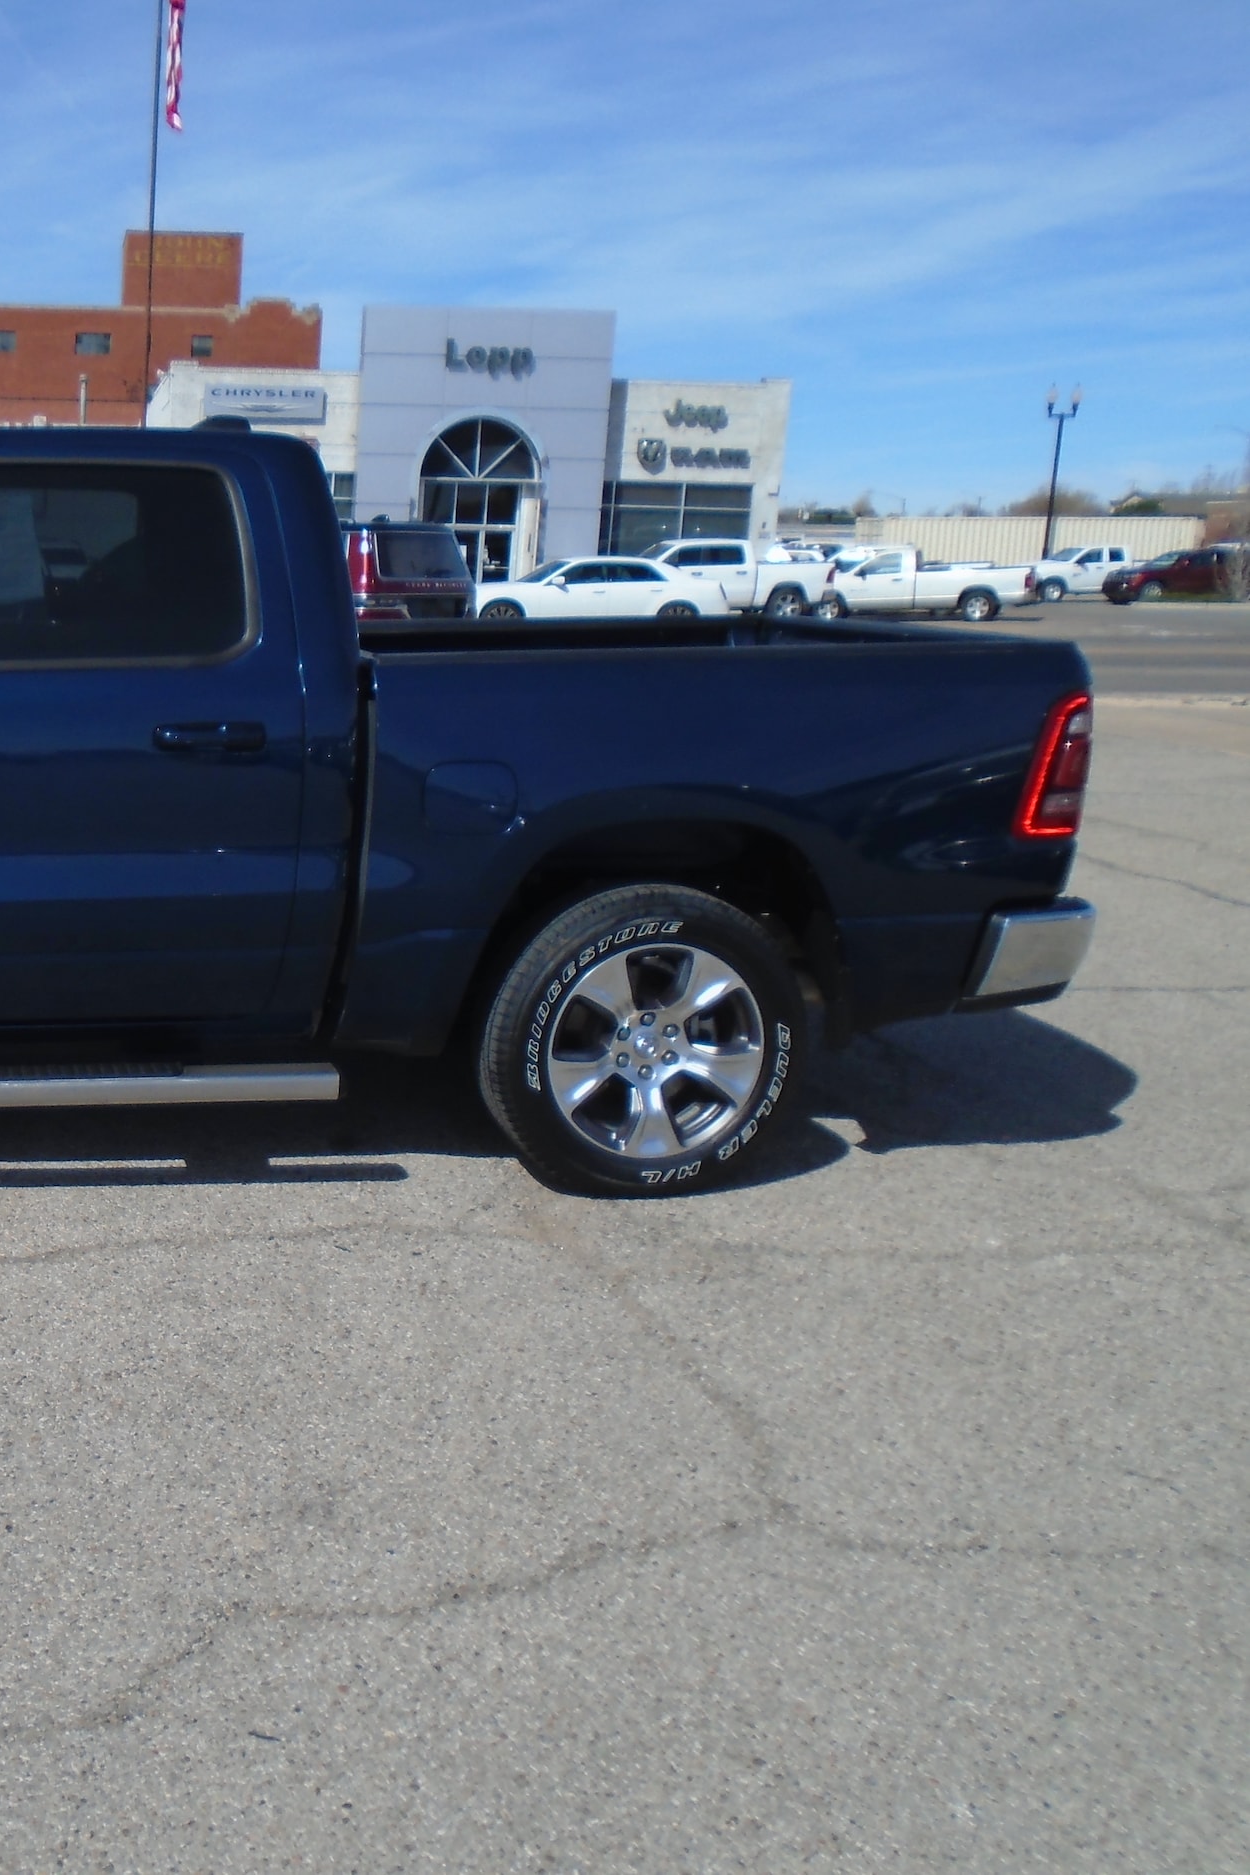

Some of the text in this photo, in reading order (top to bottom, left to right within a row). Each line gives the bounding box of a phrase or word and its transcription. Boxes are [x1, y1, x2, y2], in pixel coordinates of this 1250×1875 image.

[446, 337, 535, 381] Lopp
[210, 387, 317, 399] CHRYSLER
[664, 399, 728, 433] Jeep
[671, 446, 750, 469] RAM
[525, 920, 684, 1092] BRIDGESTONE
[641, 1022, 791, 1184] DUELER H/L
